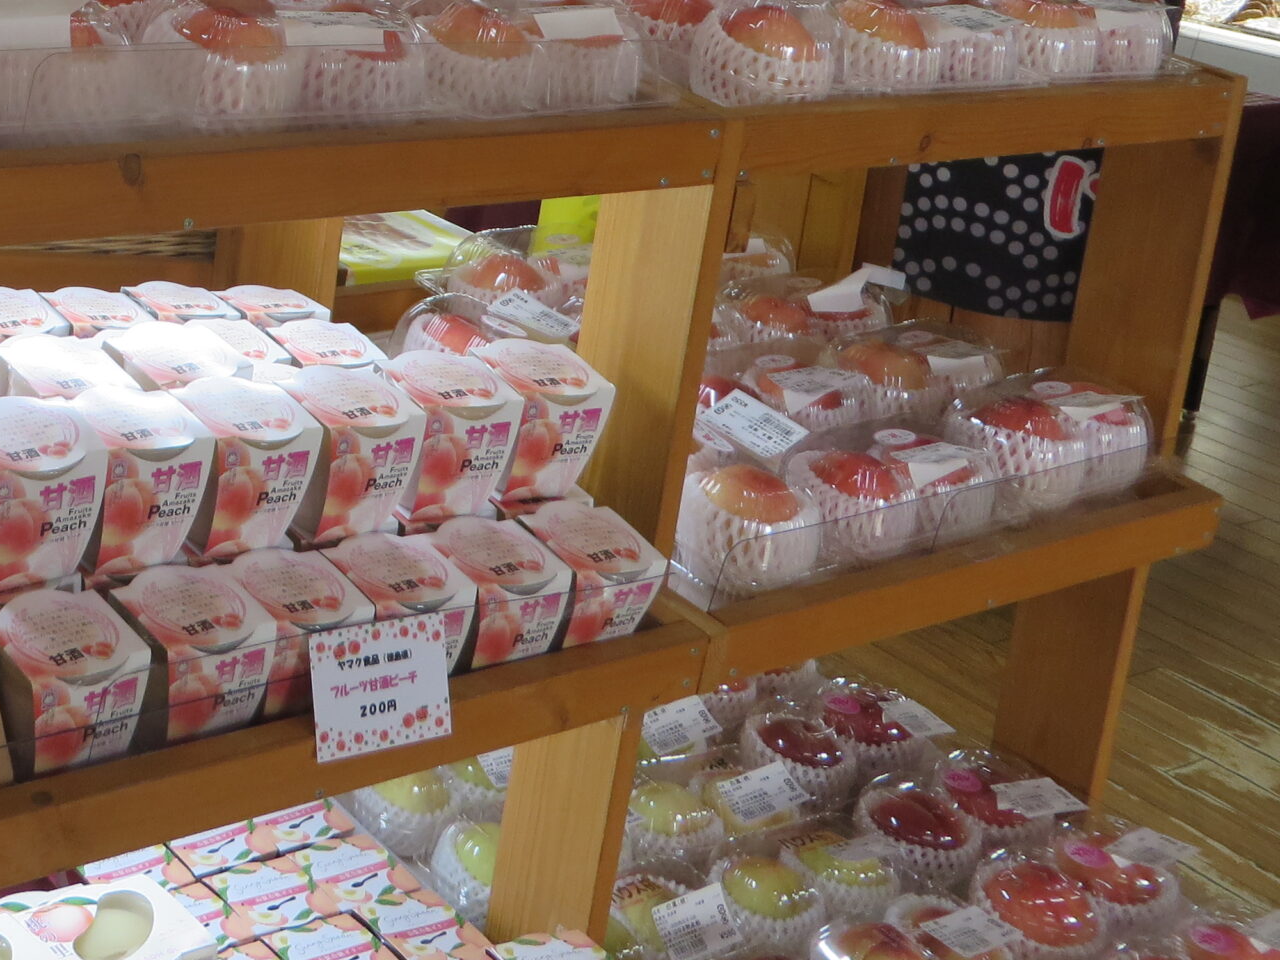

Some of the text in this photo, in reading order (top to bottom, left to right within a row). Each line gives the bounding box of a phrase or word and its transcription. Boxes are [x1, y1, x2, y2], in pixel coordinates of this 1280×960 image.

[464, 420, 512, 450] 甘酒
[558, 406, 603, 435] 甘酒
[370, 436, 416, 468] 甘酒
[551, 441, 588, 458] Peach
[150, 460, 203, 494] 甘酒
[261, 448, 312, 482] 甘酒
[459, 457, 499, 474] Peach
[39, 475, 98, 513] 甘酒
[256, 489, 298, 508] Peach
[364, 475, 405, 493] Peach
[39, 518, 88, 537] Peach
[147, 504, 192, 522] Peach
[520, 592, 562, 621] 甘酒
[214, 647, 267, 683] 甘酒
[82, 677, 140, 713] 甘酒
[360, 699, 398, 718] 200円
